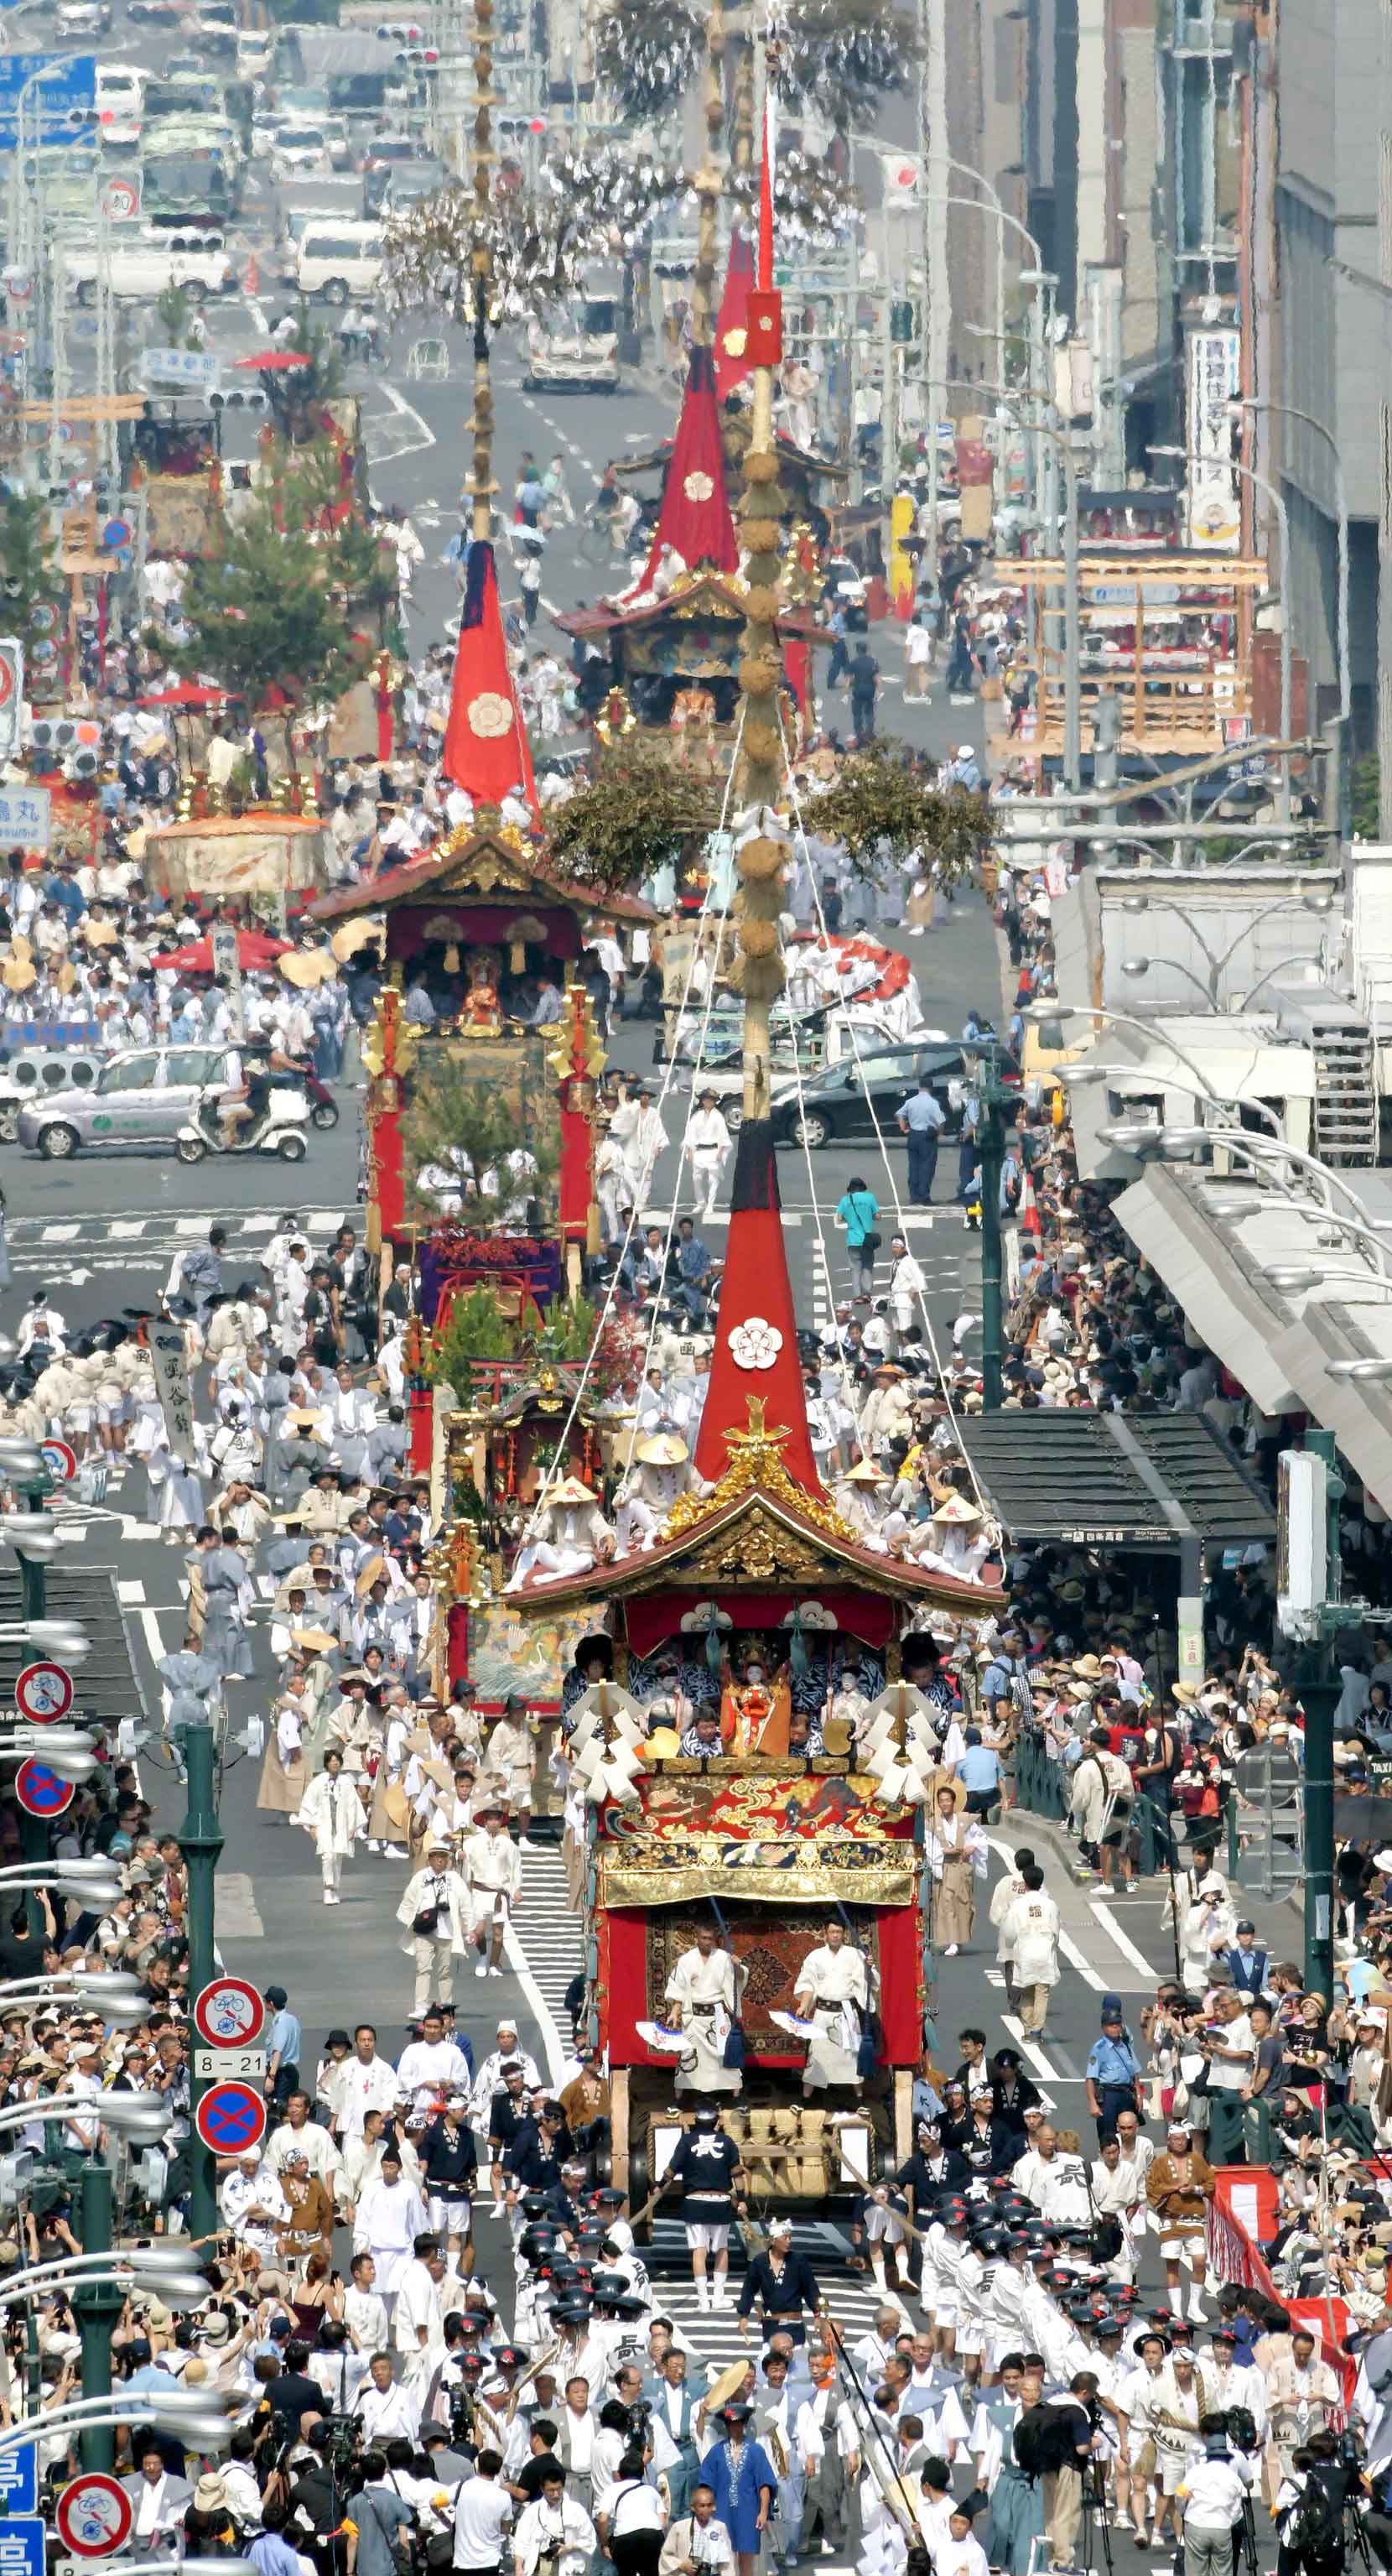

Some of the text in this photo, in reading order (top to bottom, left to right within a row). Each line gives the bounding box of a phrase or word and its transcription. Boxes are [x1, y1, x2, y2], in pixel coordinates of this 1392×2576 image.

[1370, 1762, 1392, 1772] TAXI
[691, 2134, 725, 2159] 長
[1055, 2163, 1088, 2188] 長
